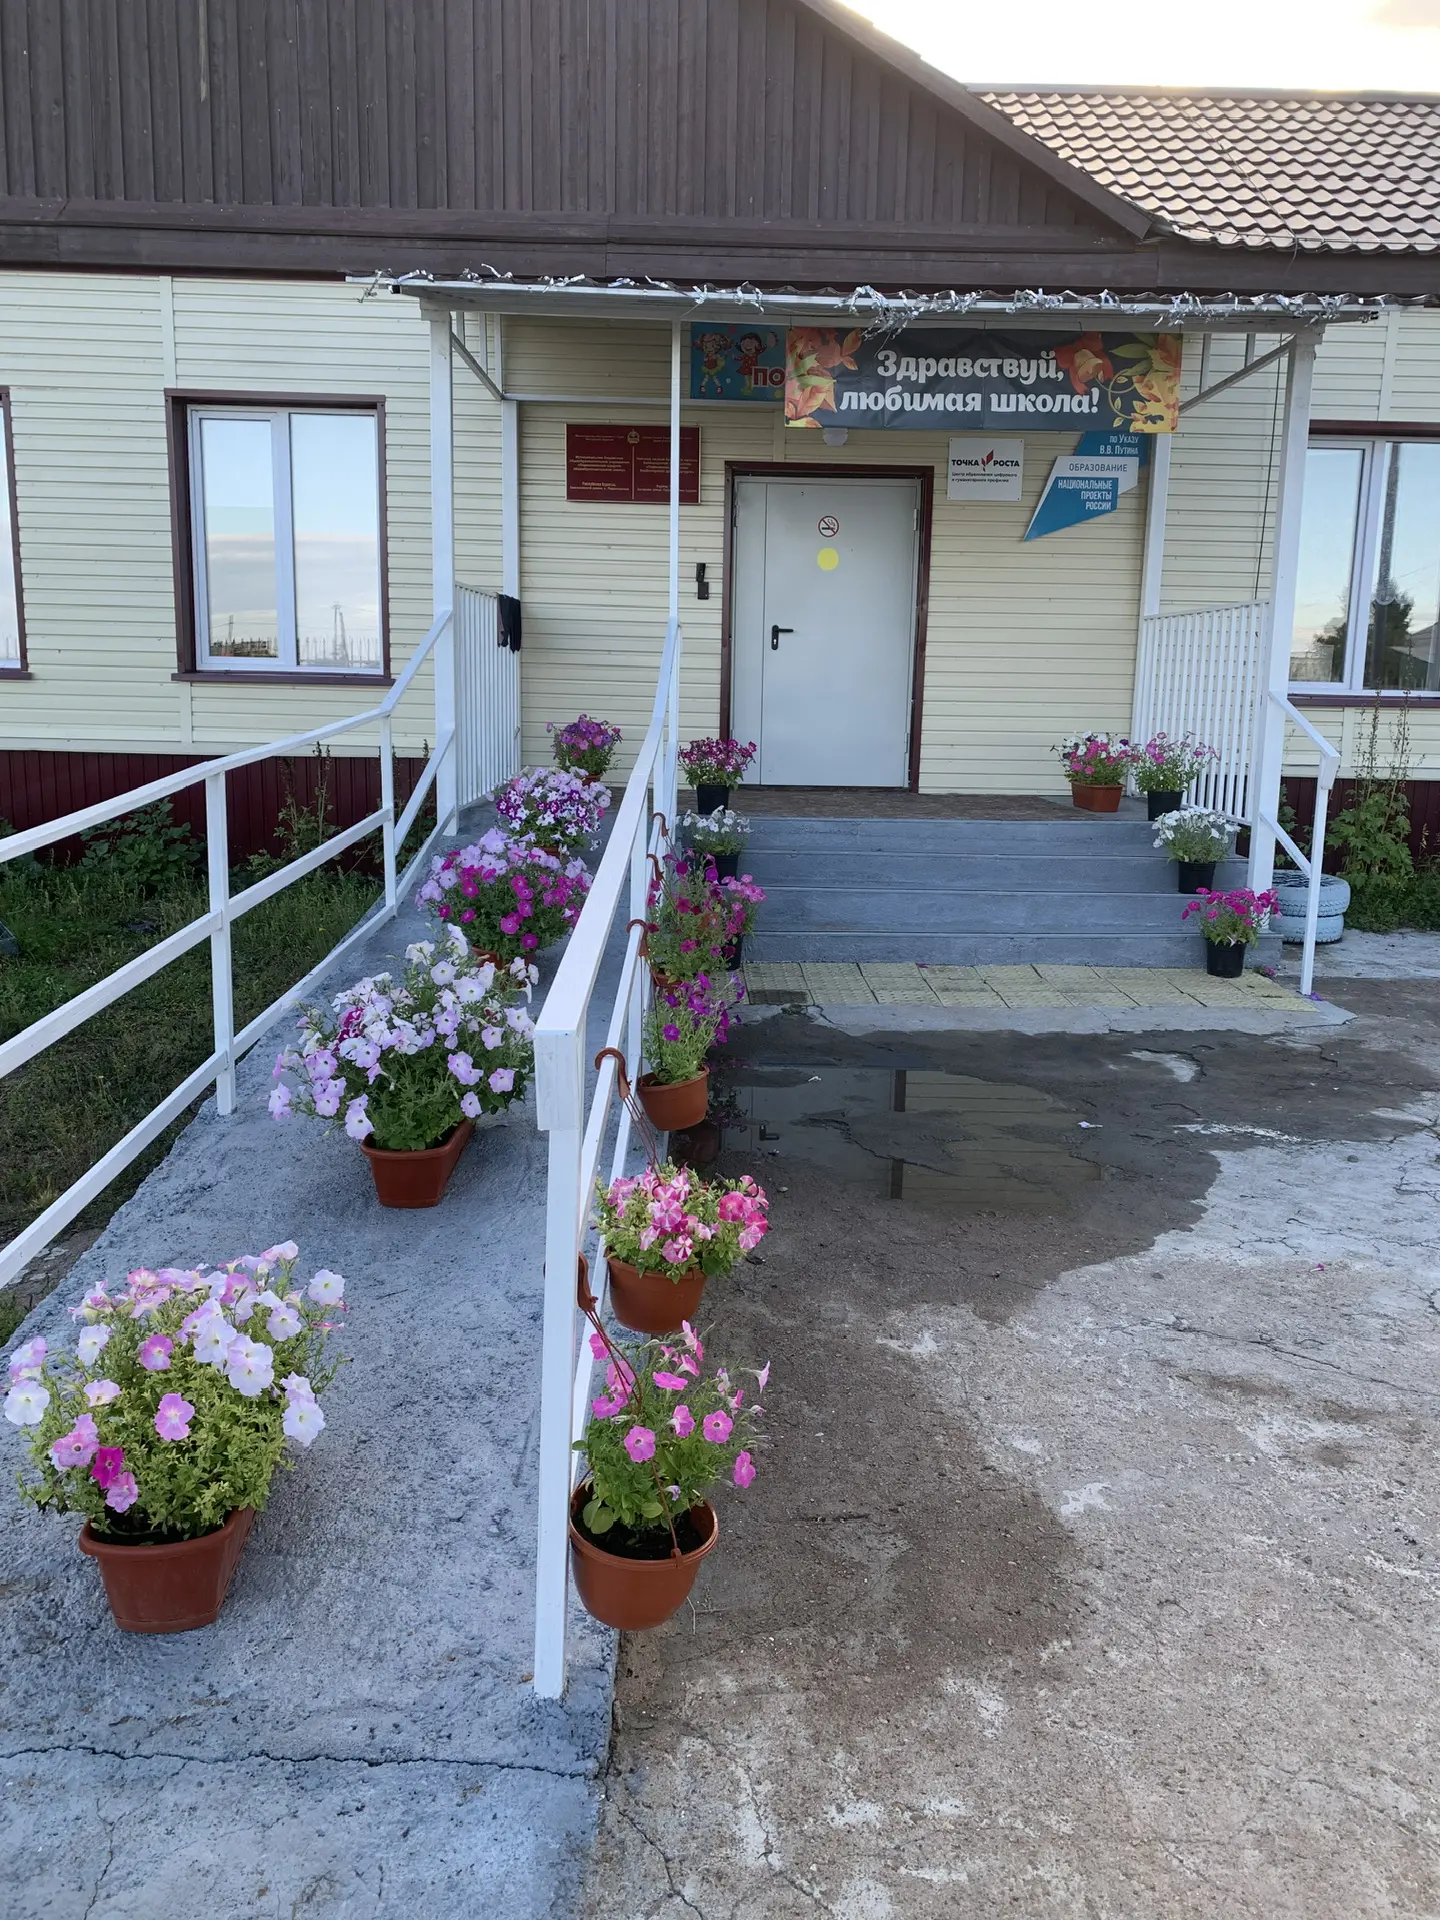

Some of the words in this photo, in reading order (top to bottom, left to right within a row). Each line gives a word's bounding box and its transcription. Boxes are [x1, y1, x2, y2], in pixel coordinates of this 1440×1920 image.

[877, 349, 1064, 384] Здравствуй,
[839, 387, 982, 413] любимая
[990, 386, 1100, 414] школа!
[993, 459, 1020, 467] РОСТА
[1068, 463, 1128, 472] ОБРАЗОВАНИЕ
[1058, 479, 1112, 490] НАЦИОНАЛЬНЫЕ
[1081, 491, 1112, 500] ПРОЕКТЫ
[1085, 501, 1111, 510] РОССИИ
